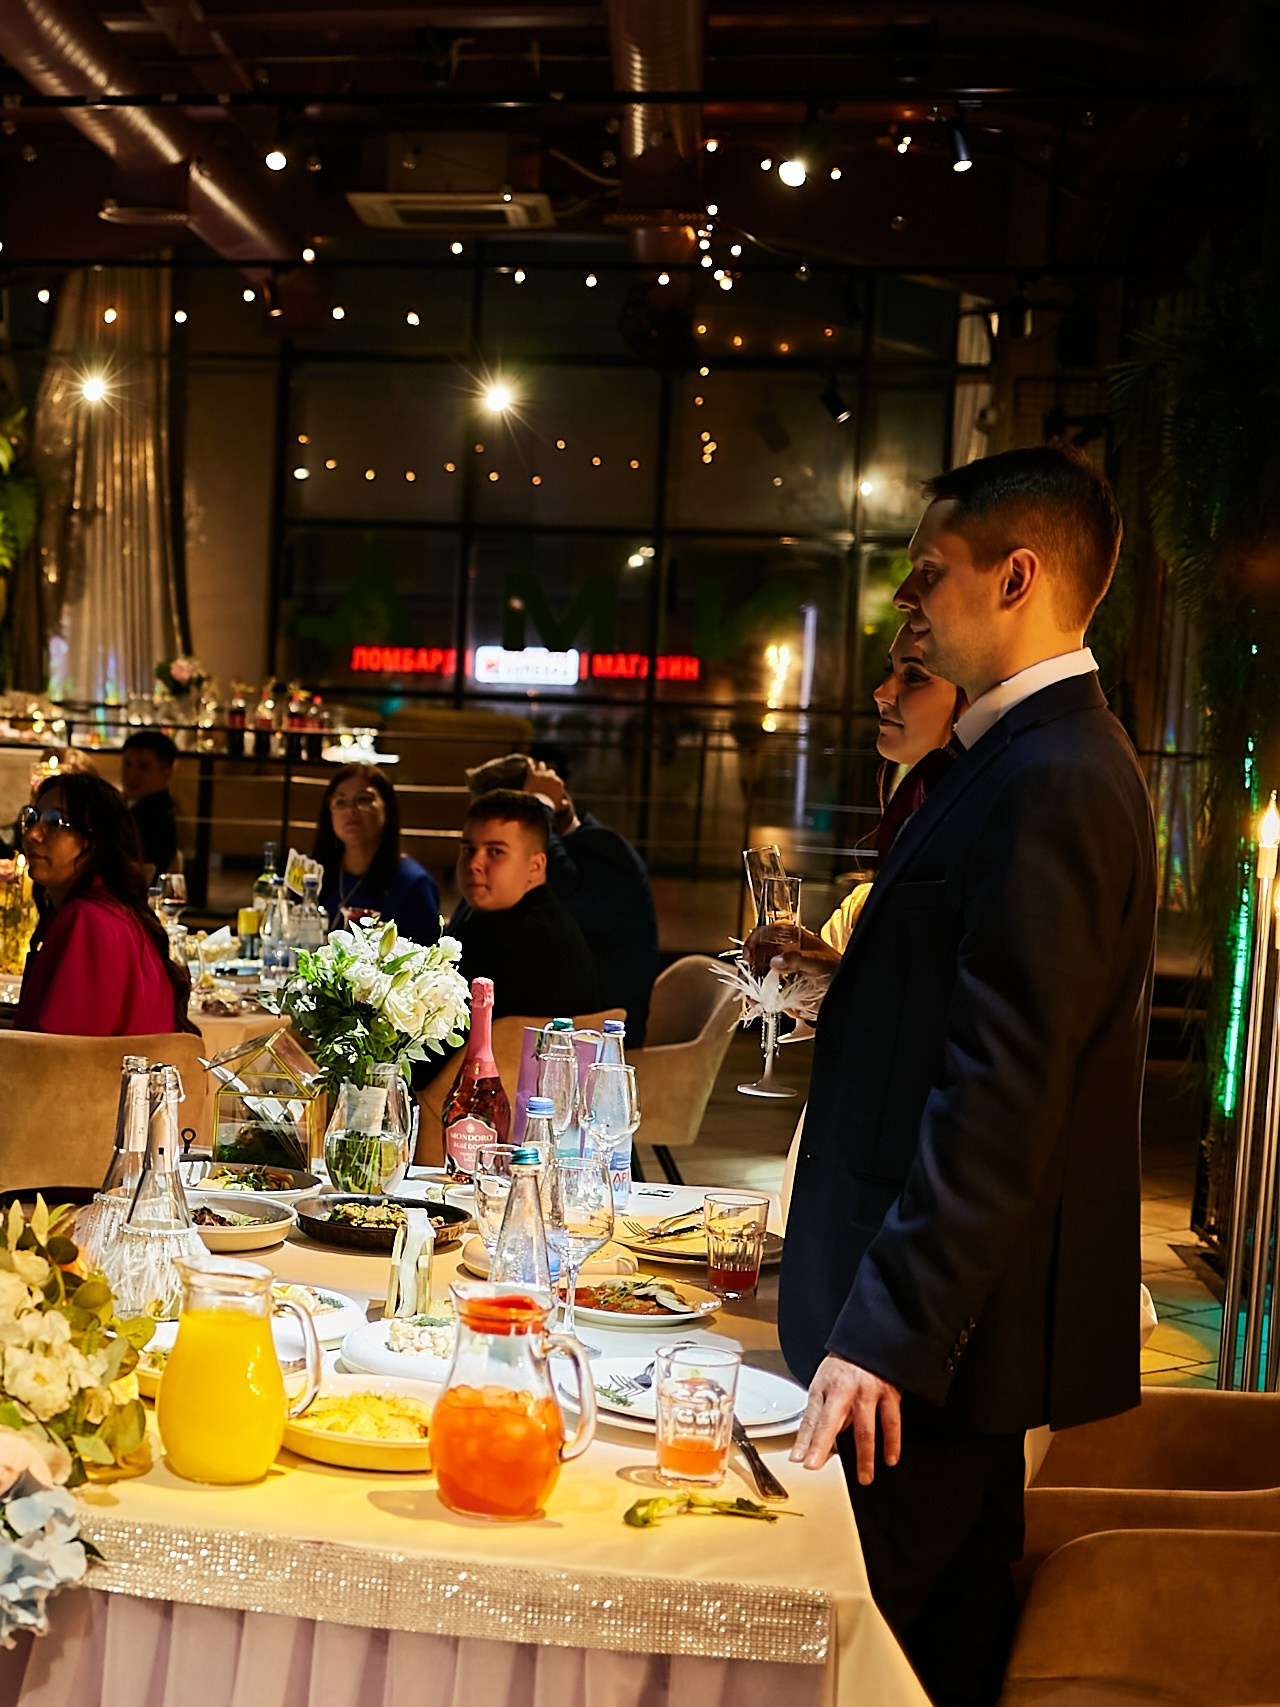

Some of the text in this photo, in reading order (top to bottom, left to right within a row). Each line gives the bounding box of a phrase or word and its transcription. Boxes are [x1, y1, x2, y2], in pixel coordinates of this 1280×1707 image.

[350, 645, 699, 680] ЛОМБАРД МАГАЗИН
[450, 1131, 493, 1142] MONDORO
